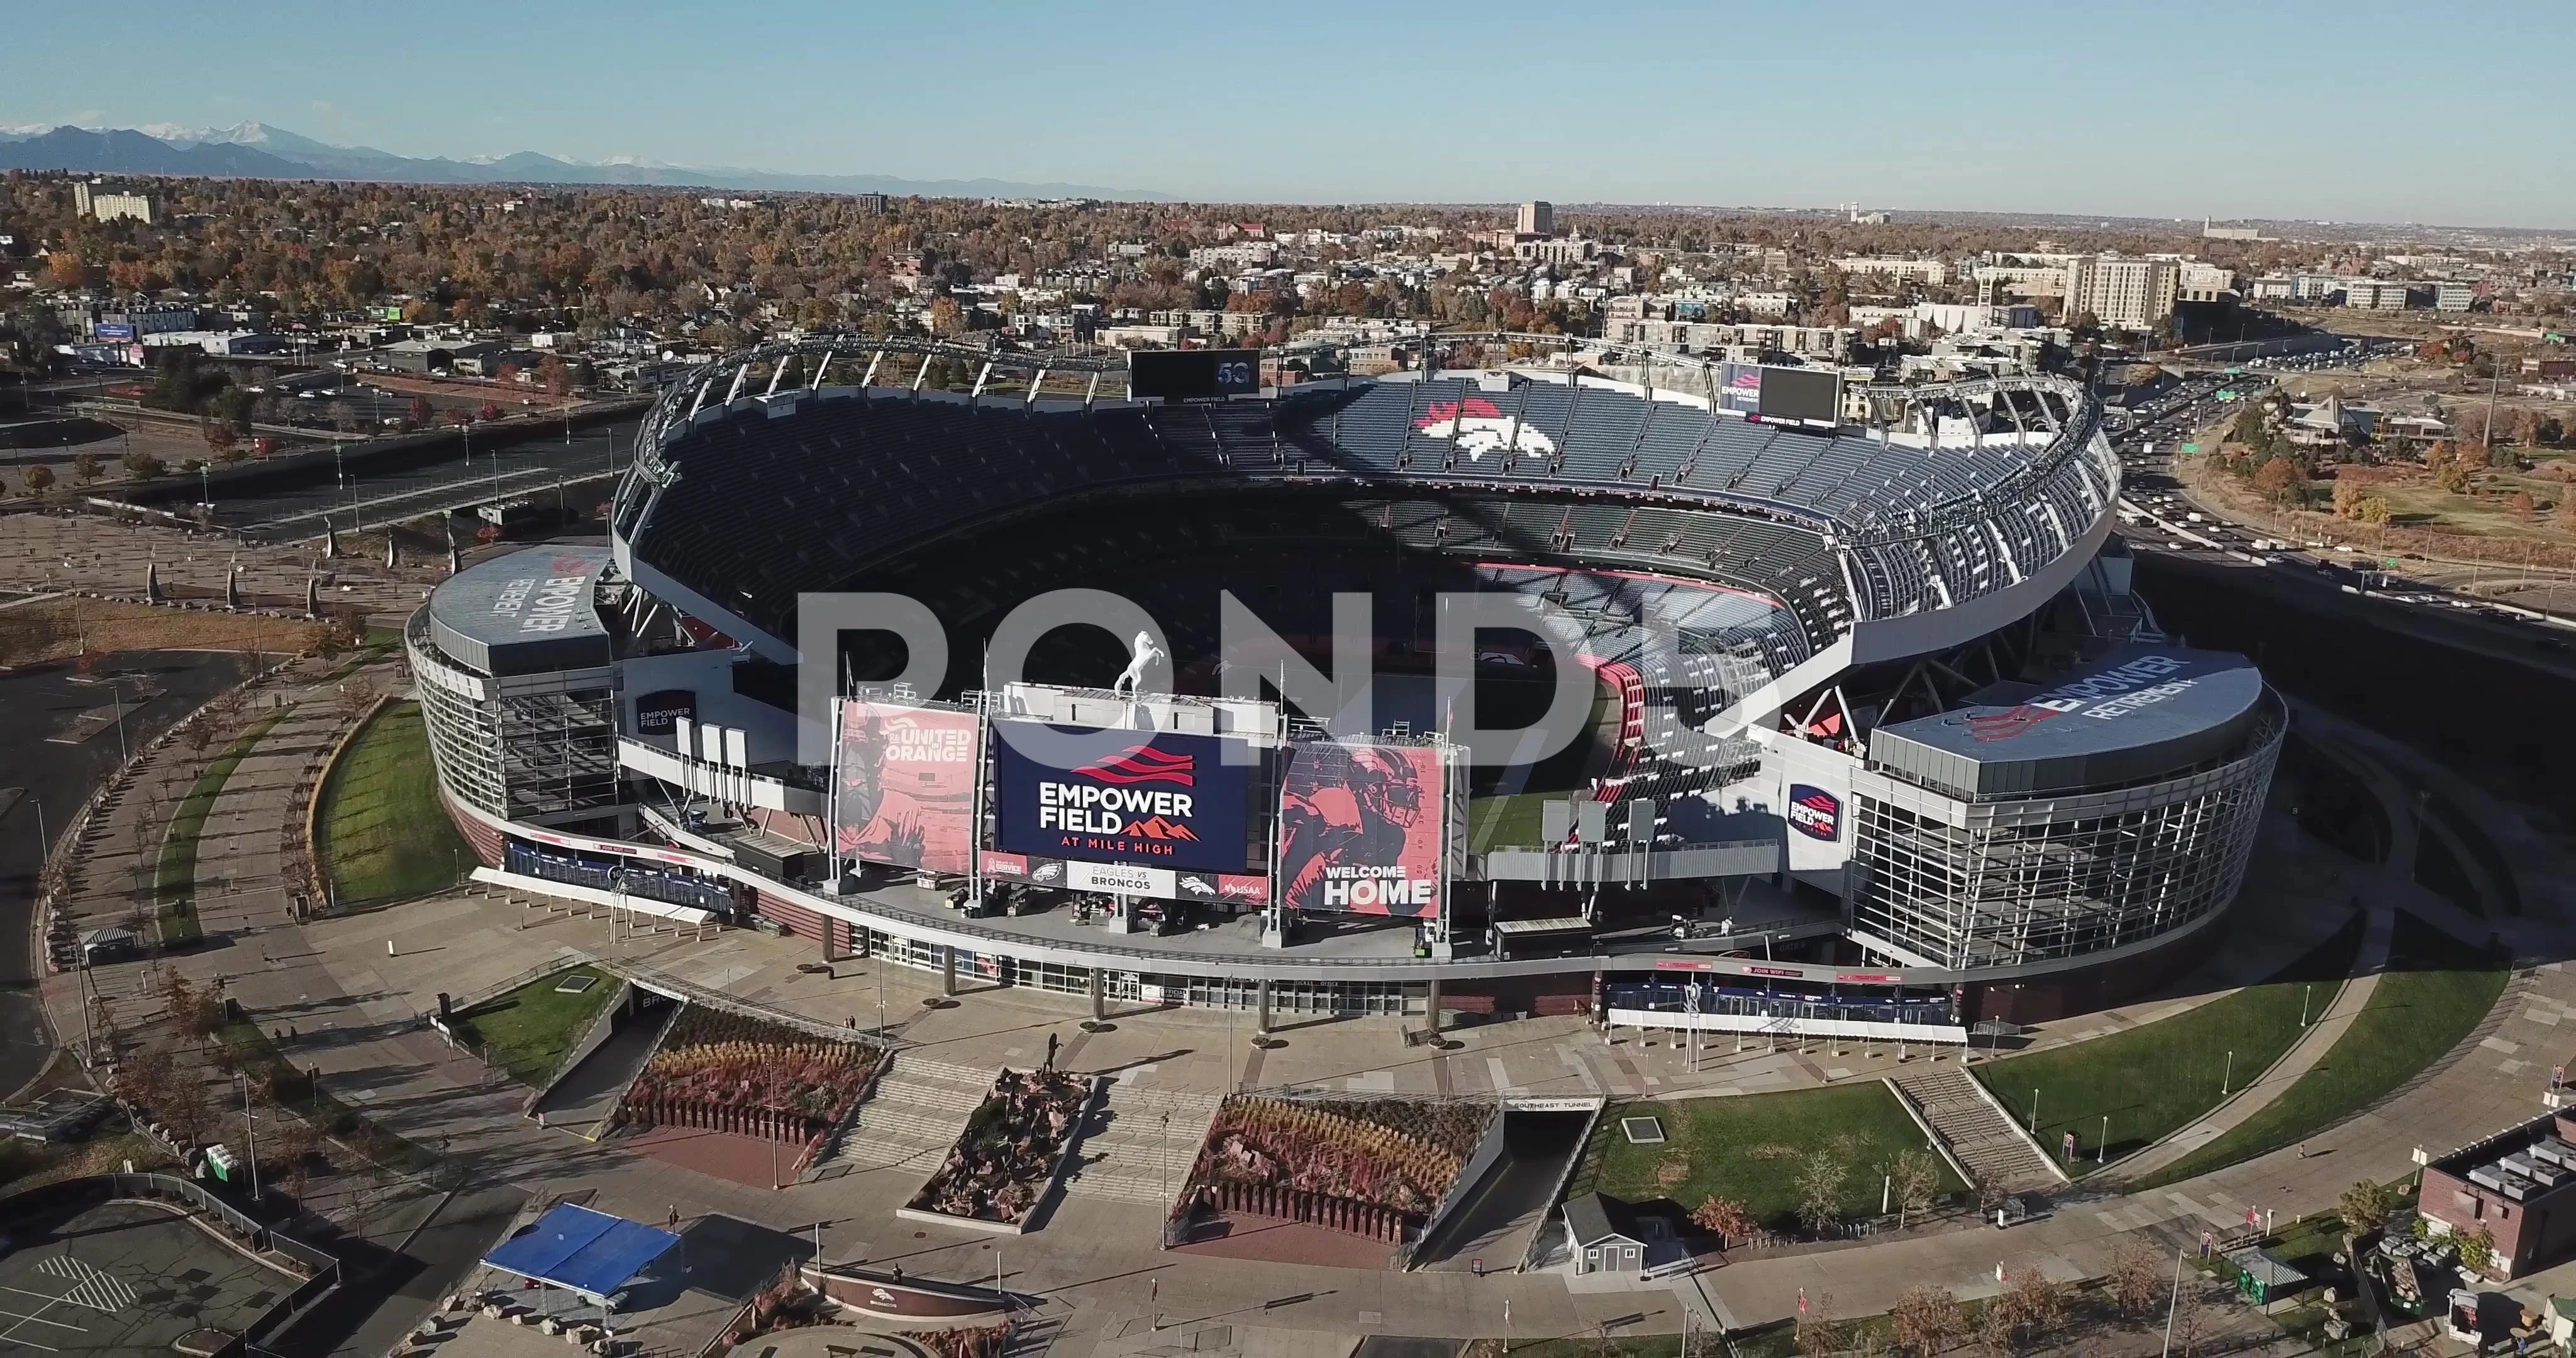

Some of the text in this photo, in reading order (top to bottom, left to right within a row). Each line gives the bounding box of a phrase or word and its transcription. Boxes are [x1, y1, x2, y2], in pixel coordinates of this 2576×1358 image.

[1217, 362, 1250, 384] 5G
[1721, 386, 1759, 397] EMPOWER
[1761, 416, 1785, 424] EMPOWER
[519, 577, 586, 632] EMPOWER
[2023, 655, 2192, 712] EMPOWER
[2081, 678, 2199, 720] RETIREMENT
[640, 707, 691, 720] EMPOWER
[641, 717, 668, 727] FIELD
[886, 745, 967, 762] ORANGE
[1040, 781, 1193, 817] EMPOWER
[1040, 806, 1123, 835] FIELD
[1790, 801, 1835, 825] EMPOWER
[1790, 810, 1814, 825] FIELD
[1061, 836, 1173, 856] AT MILE HIGH
[611, 869, 621, 878] 10
[1093, 866, 1134, 878] EAGLES
[1325, 866, 1406, 879] WELCOME
[1091, 876, 1150, 889] BRONCOS
[1237, 885, 1261, 895] USAA
[1324, 880, 1432, 906] HOME
